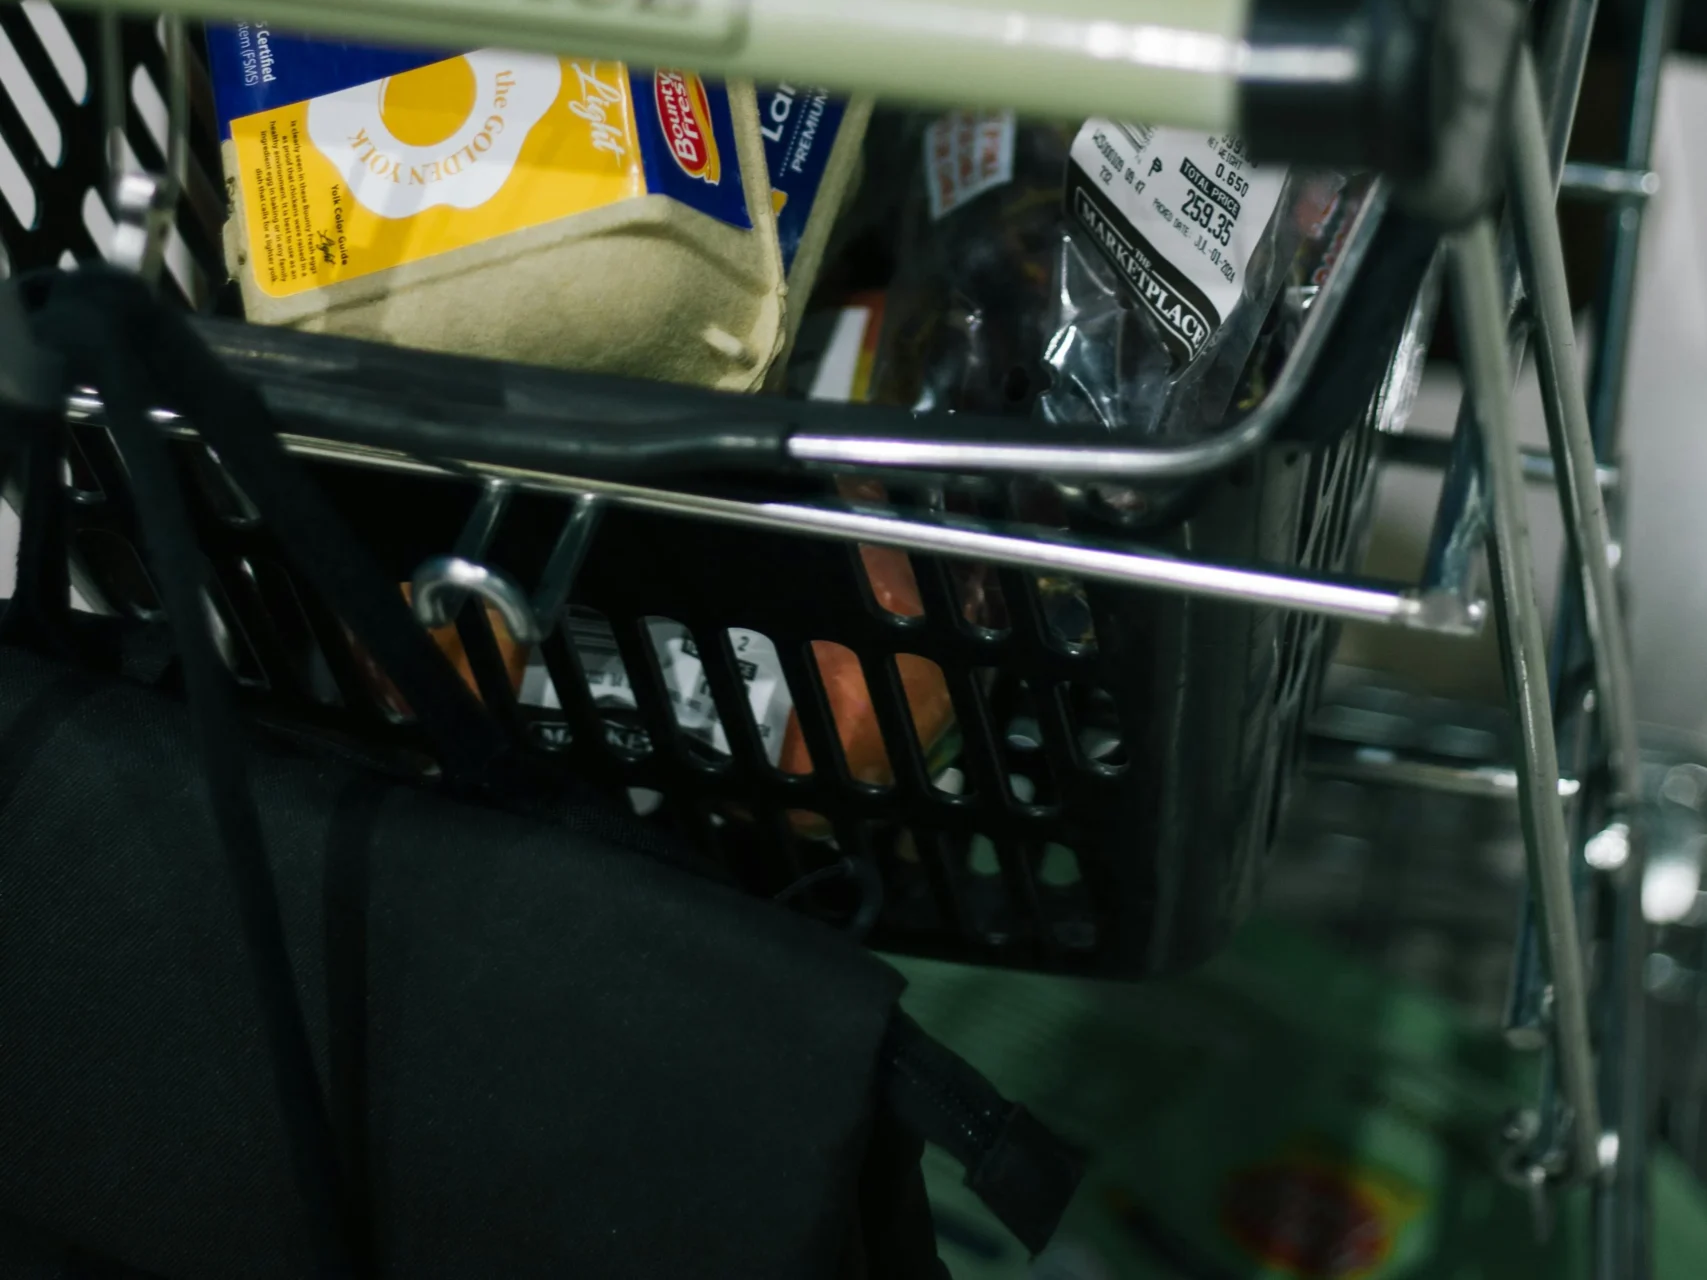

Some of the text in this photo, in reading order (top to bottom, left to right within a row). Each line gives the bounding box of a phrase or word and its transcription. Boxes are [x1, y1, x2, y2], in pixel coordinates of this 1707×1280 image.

[238, 21, 259, 86] stem (FSMS)
[256, 30, 277, 83] Certified
[568, 60, 626, 168] Light
[659, 72, 698, 162] Bounty
[269, 120, 279, 149] healthy
[282, 135, 288, 144] as
[347, 70, 516, 186] the GOLDEN YOLK
[260, 130, 271, 170] ingredient
[292, 128, 302, 153] clearly
[282, 145, 293, 166] proof
[1218, 146, 1244, 171] WEIGHT
[255, 168, 264, 185] dish
[265, 171, 274, 187] egg
[287, 166, 295, 183] that
[298, 173, 305, 182] in
[1215, 162, 1249, 198] 0.650
[258, 185, 266, 202] that
[269, 187, 276, 196] in
[300, 182, 308, 203] these
[1183, 161, 1239, 216] TOTAL PRICE
[261, 203, 269, 220] calls
[271, 196, 280, 223] baking
[289, 184, 299, 217] chickens
[274, 224, 280, 232] or
[283, 217, 291, 234] best
[294, 218, 302, 237] were
[302, 204, 312, 232] Bounty
[331, 184, 349, 266] Yolk Color Guide
[1181, 188, 1234, 247] 259.35
[276, 233, 281, 242] in
[285, 235, 292, 244] to
[307, 233, 316, 255] Fresh
[264, 239, 274, 265] lighter
[297, 238, 306, 262] raised
[1135, 248, 1152, 271] THE
[279, 258, 288, 282] family
[289, 260, 296, 269] as
[291, 270, 297, 280] an
[301, 263, 307, 271] in
[309, 256, 317, 275] eggs
[1082, 201, 1206, 349] MARKETPLACE
